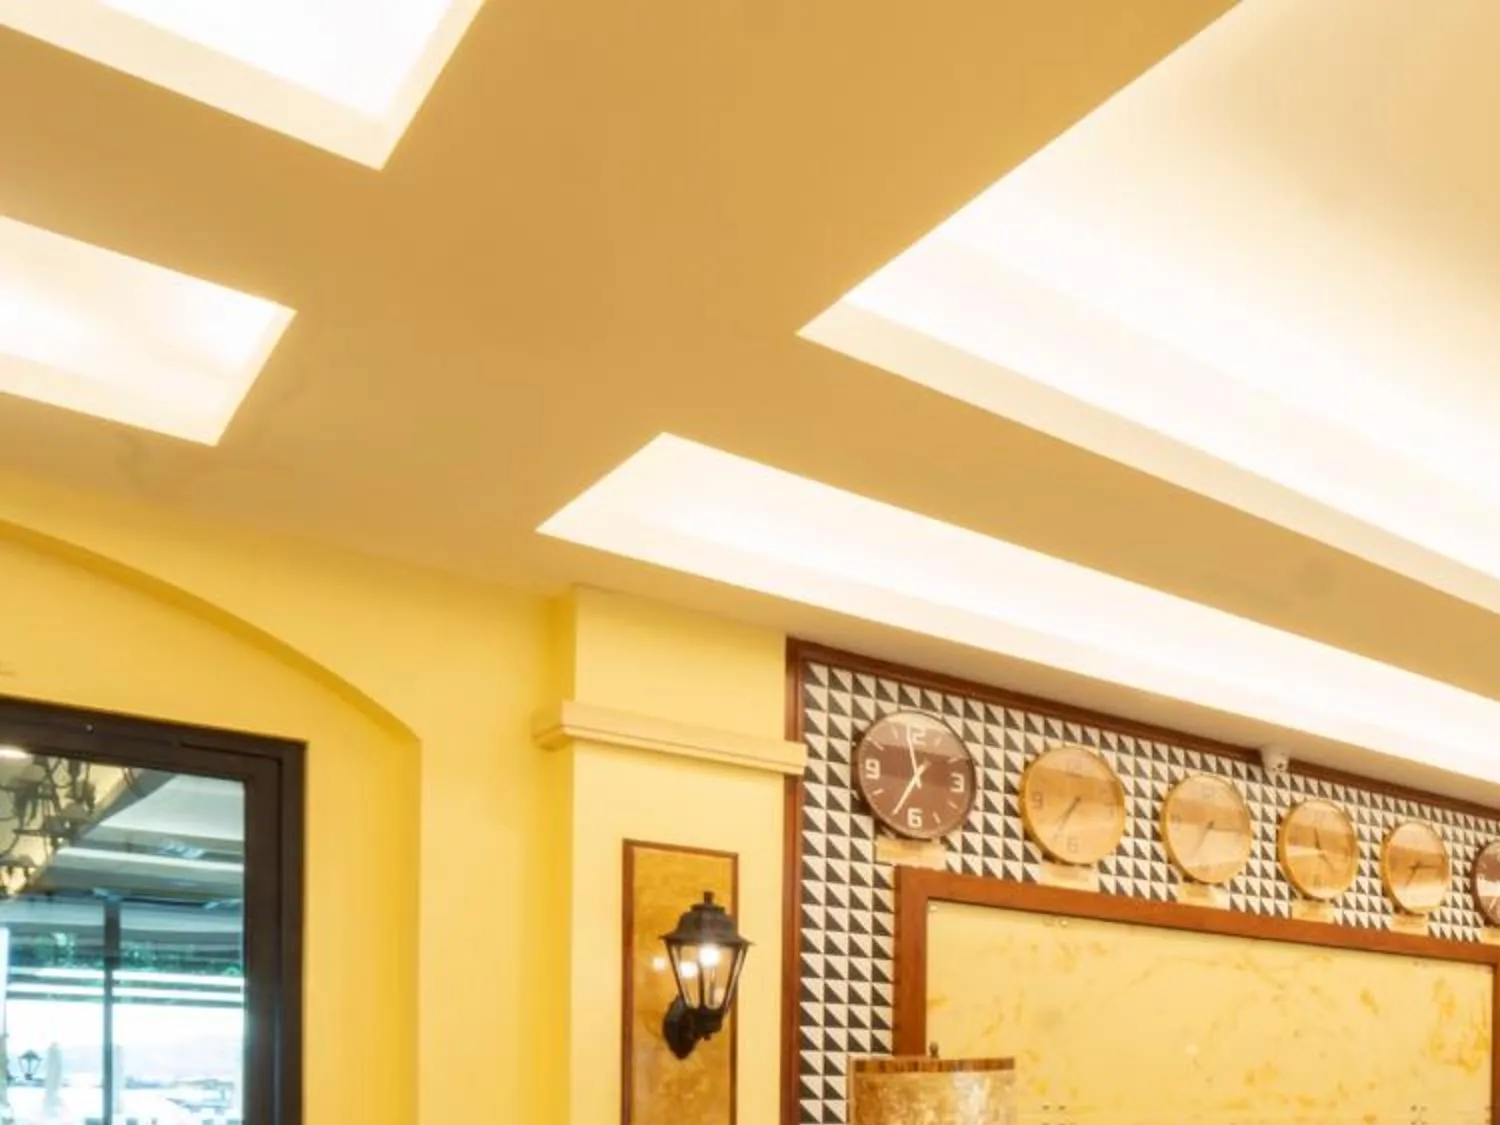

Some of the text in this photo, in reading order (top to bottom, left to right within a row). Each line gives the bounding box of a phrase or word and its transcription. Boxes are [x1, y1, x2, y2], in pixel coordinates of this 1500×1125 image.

[865, 759, 880, 780] 9
[951, 773, 965, 793] 3
[907, 808, 922, 829] 6
